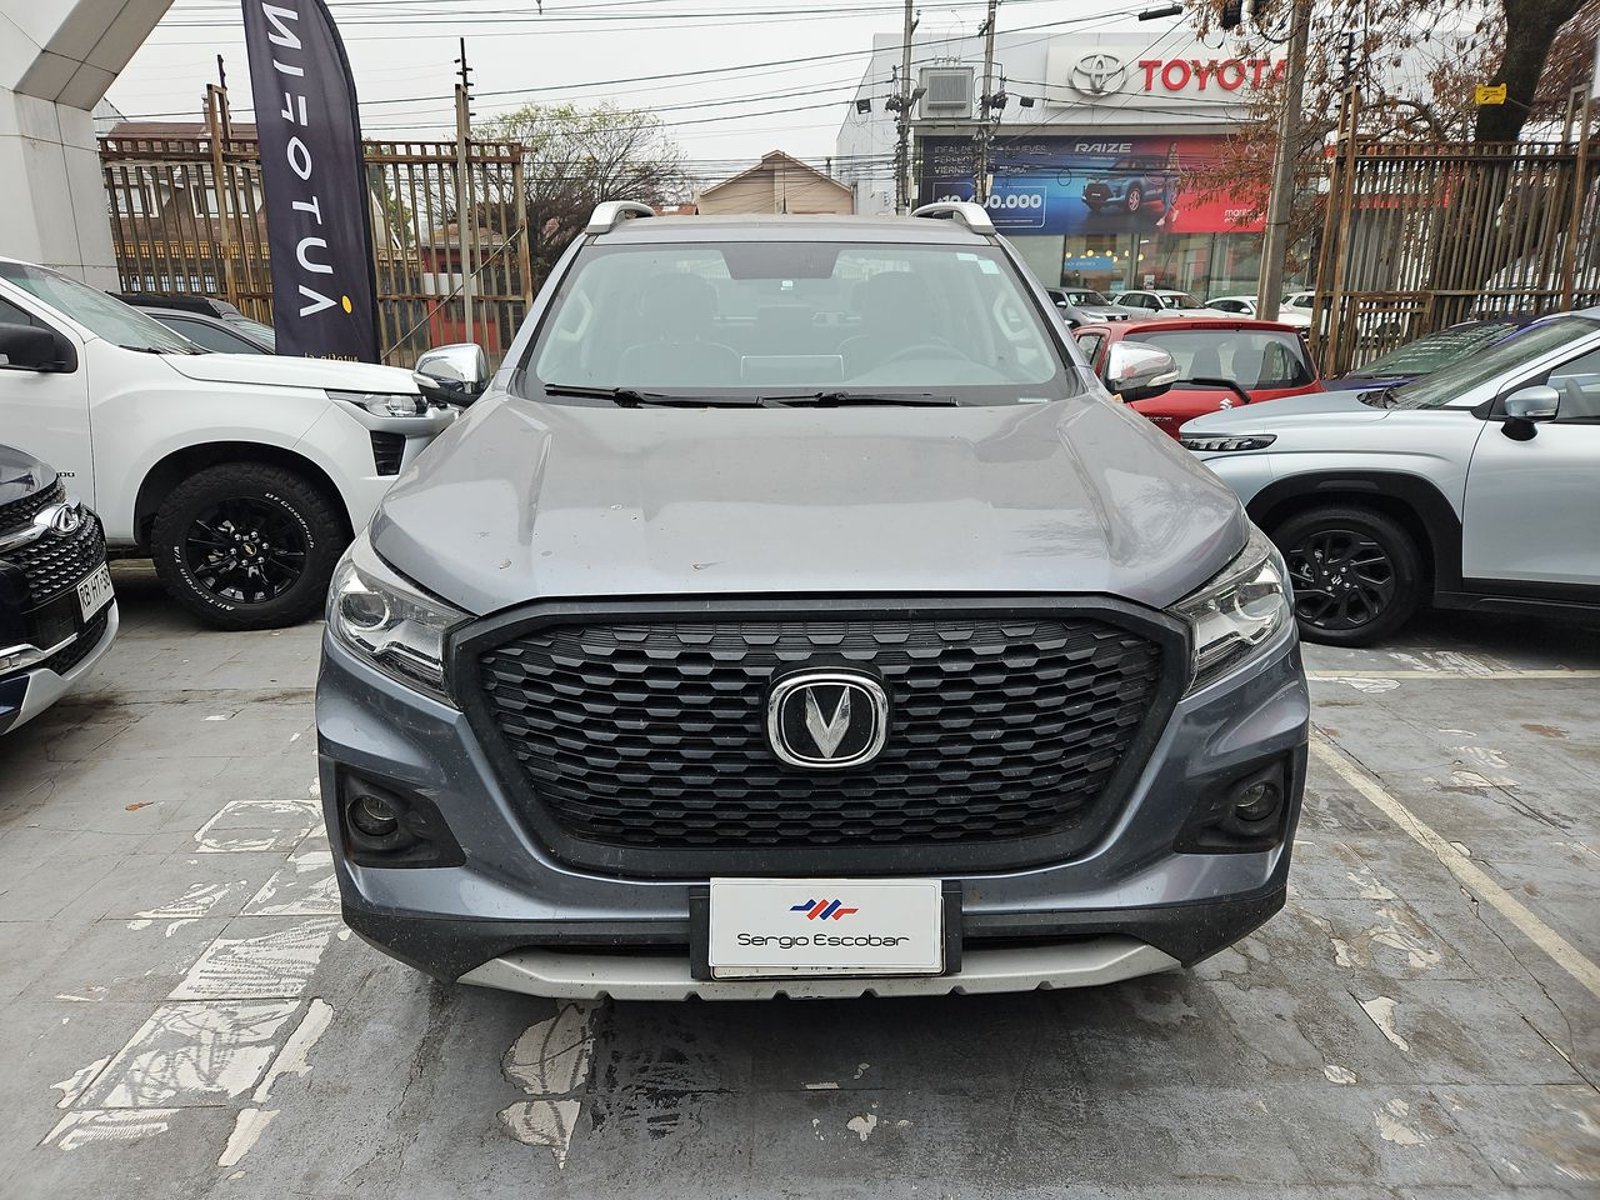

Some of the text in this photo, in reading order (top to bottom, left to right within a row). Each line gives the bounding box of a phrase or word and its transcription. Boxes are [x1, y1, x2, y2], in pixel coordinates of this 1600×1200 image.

[1074, 143, 1133, 153] RAIZE
[737, 933, 910, 949] Sergio Escobar
